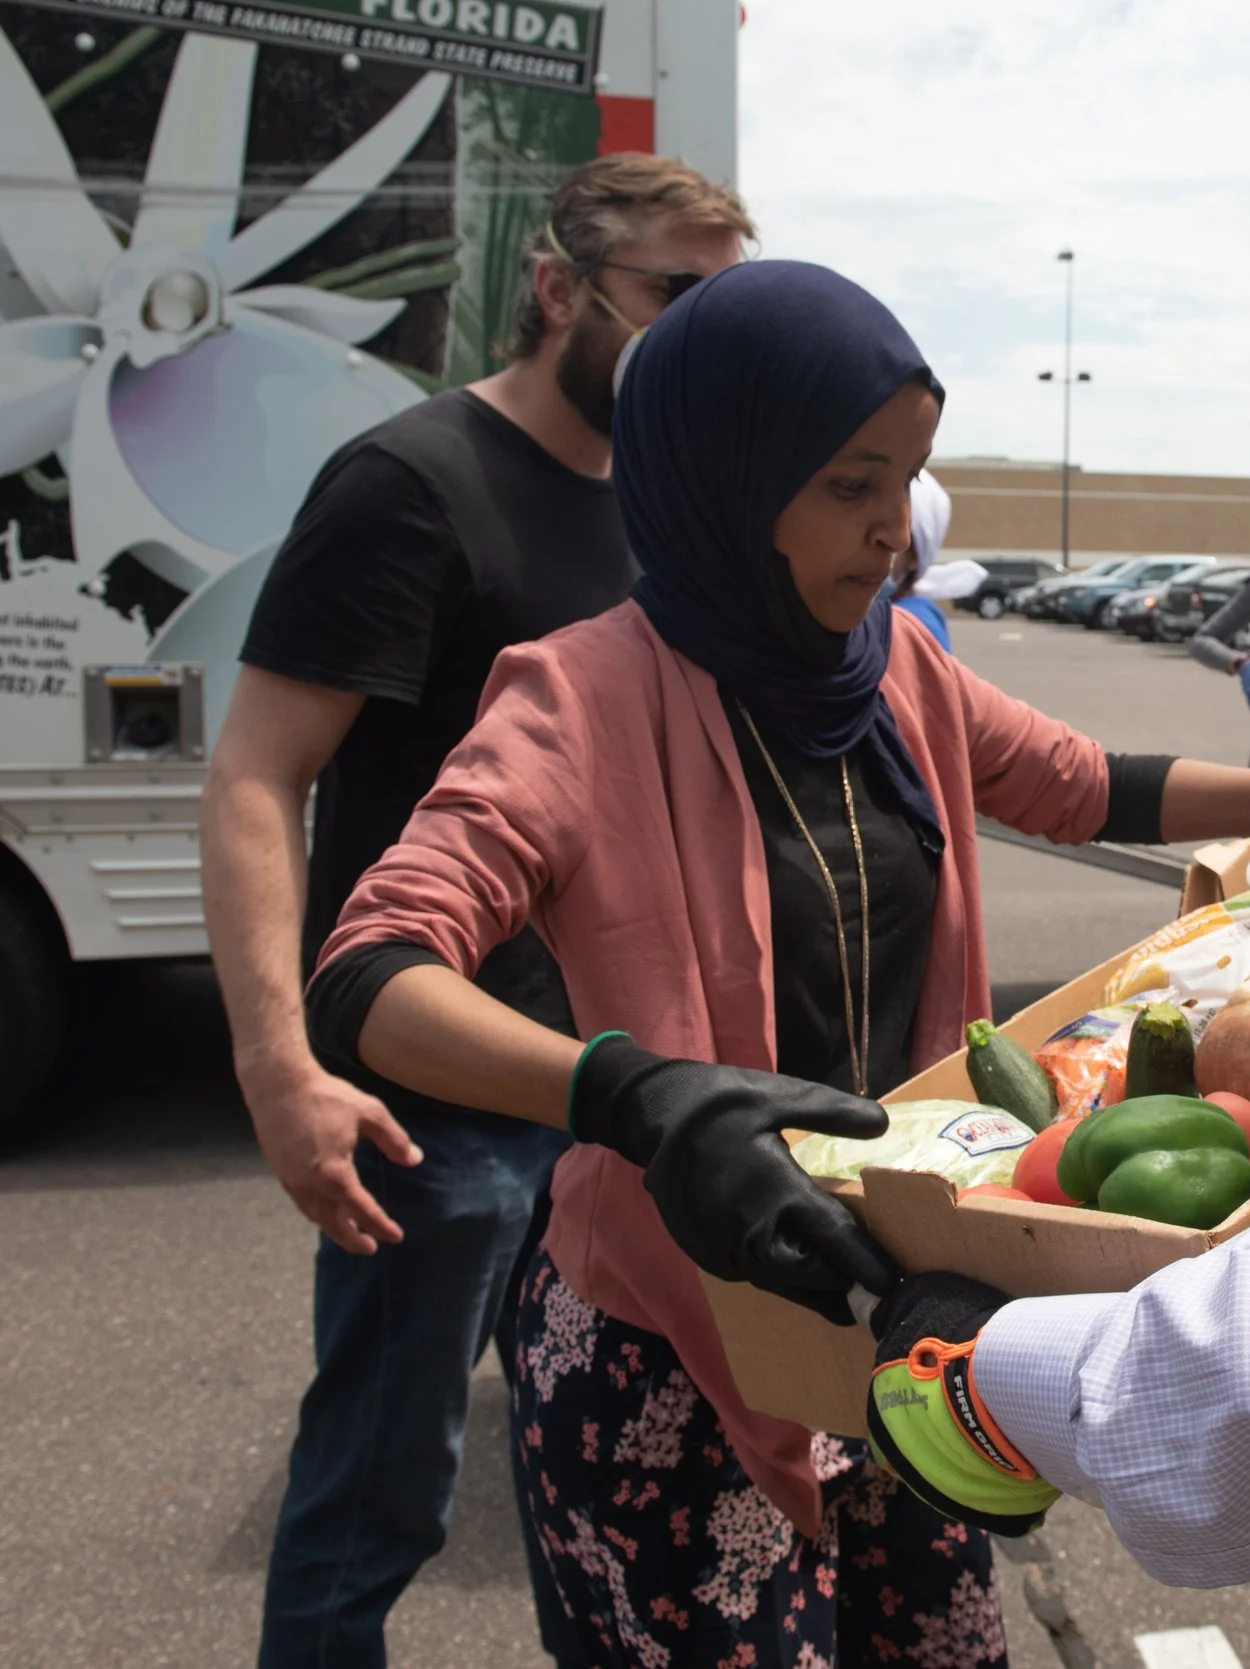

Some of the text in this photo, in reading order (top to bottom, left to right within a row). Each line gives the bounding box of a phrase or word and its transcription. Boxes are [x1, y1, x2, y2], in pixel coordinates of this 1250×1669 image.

[193, 2, 228, 25] THE
[358, 27, 430, 56] STRAND
[432, 40, 488, 66] STATE
[489, 49, 580, 82] PRESERVE
[953, 1374, 978, 1429] FIRM
